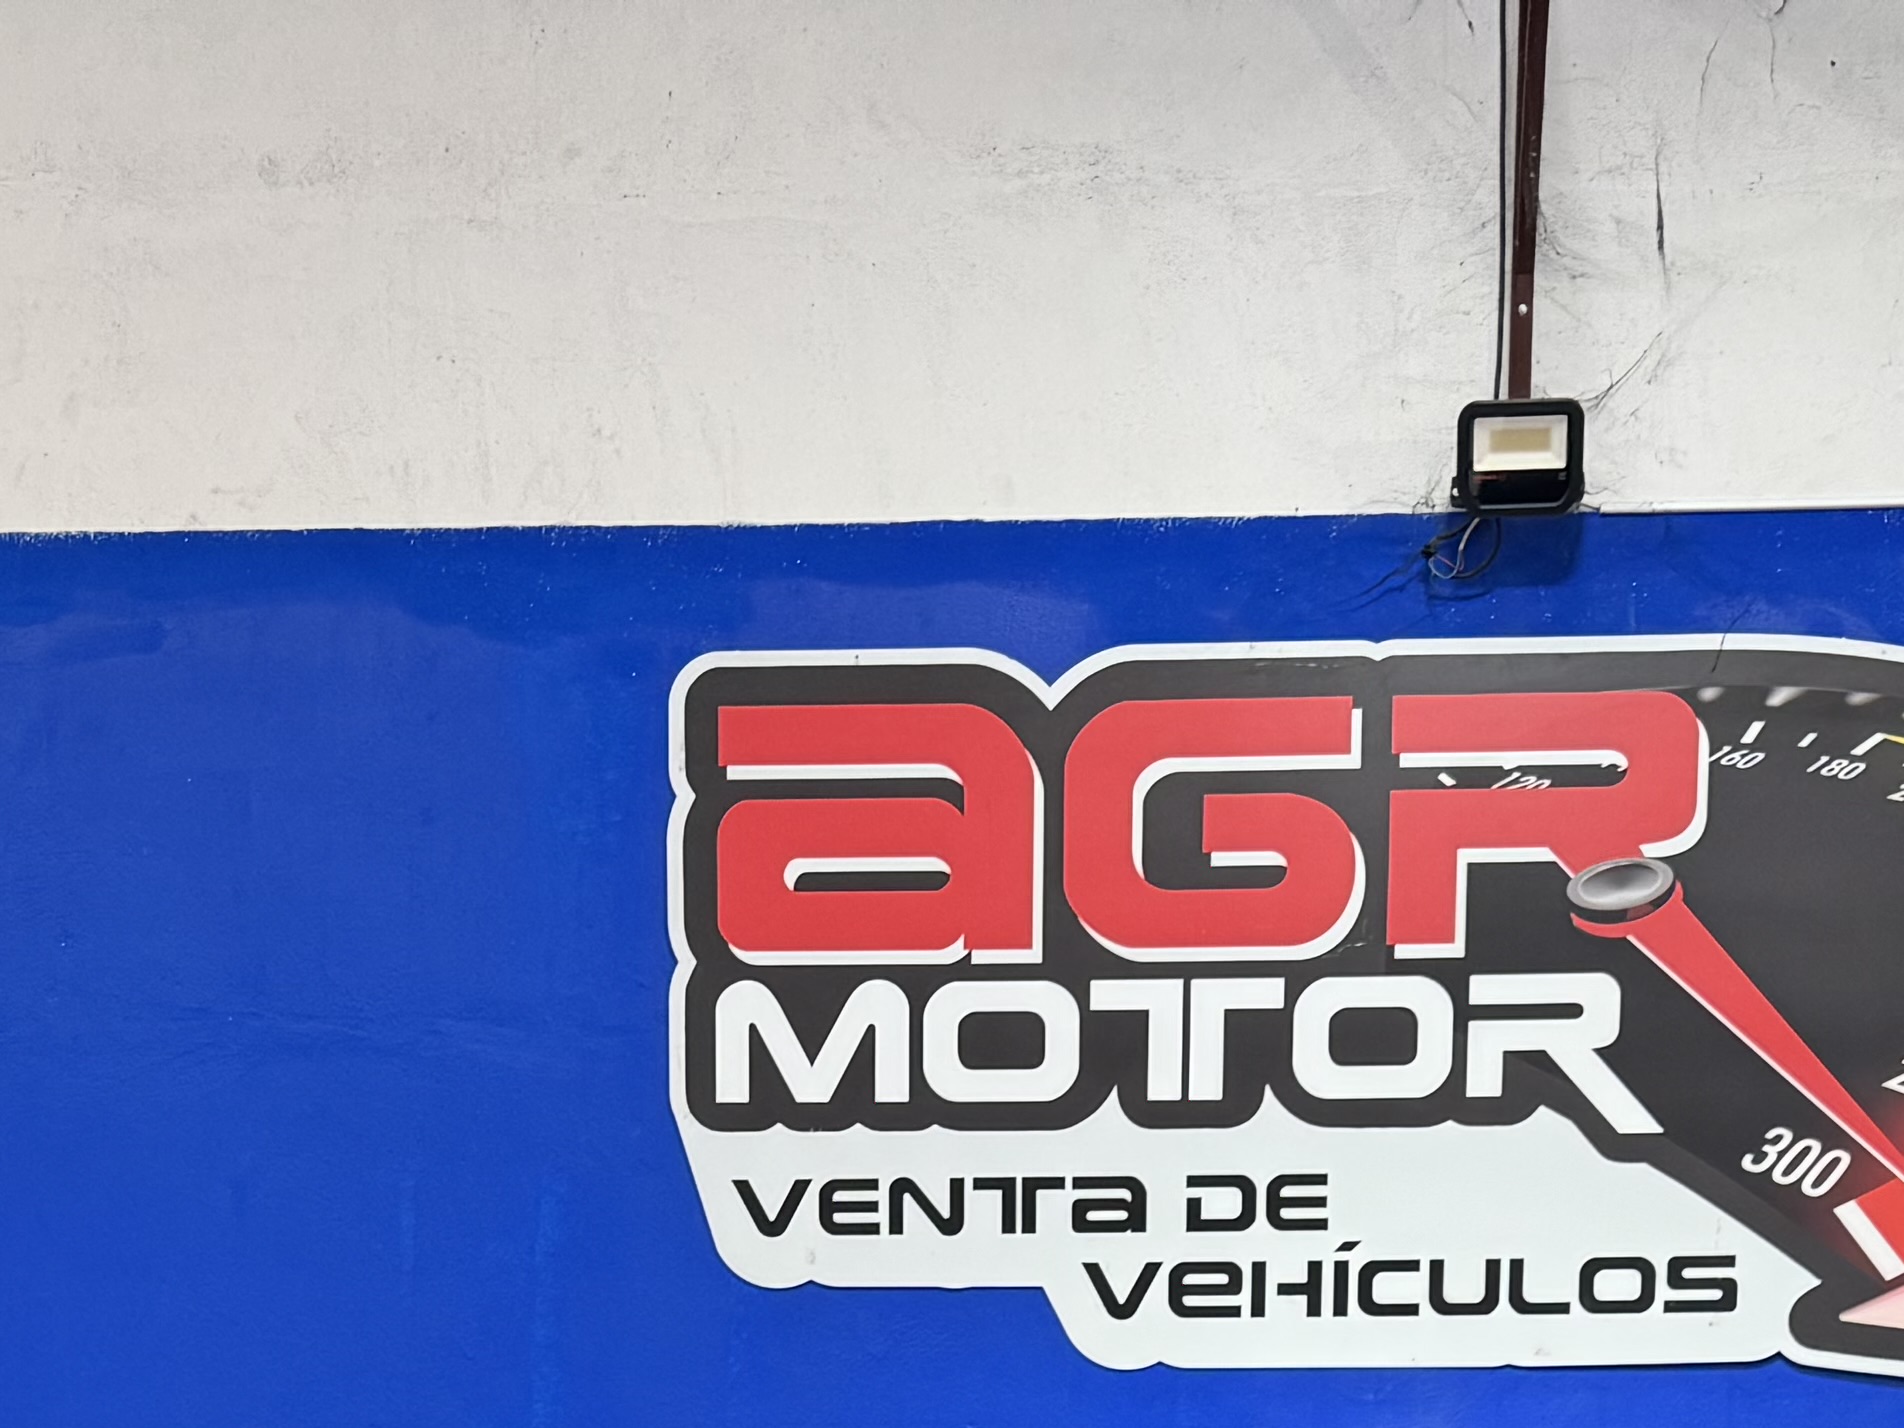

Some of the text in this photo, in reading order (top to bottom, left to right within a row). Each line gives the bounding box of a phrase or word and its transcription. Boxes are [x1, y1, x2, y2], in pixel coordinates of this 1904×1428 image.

[1805, 754, 1868, 782] 180
[715, 974, 1665, 1134] MOTOR
[1740, 1126, 1852, 1198] 300
[1185, 1173, 1329, 1233] DE
